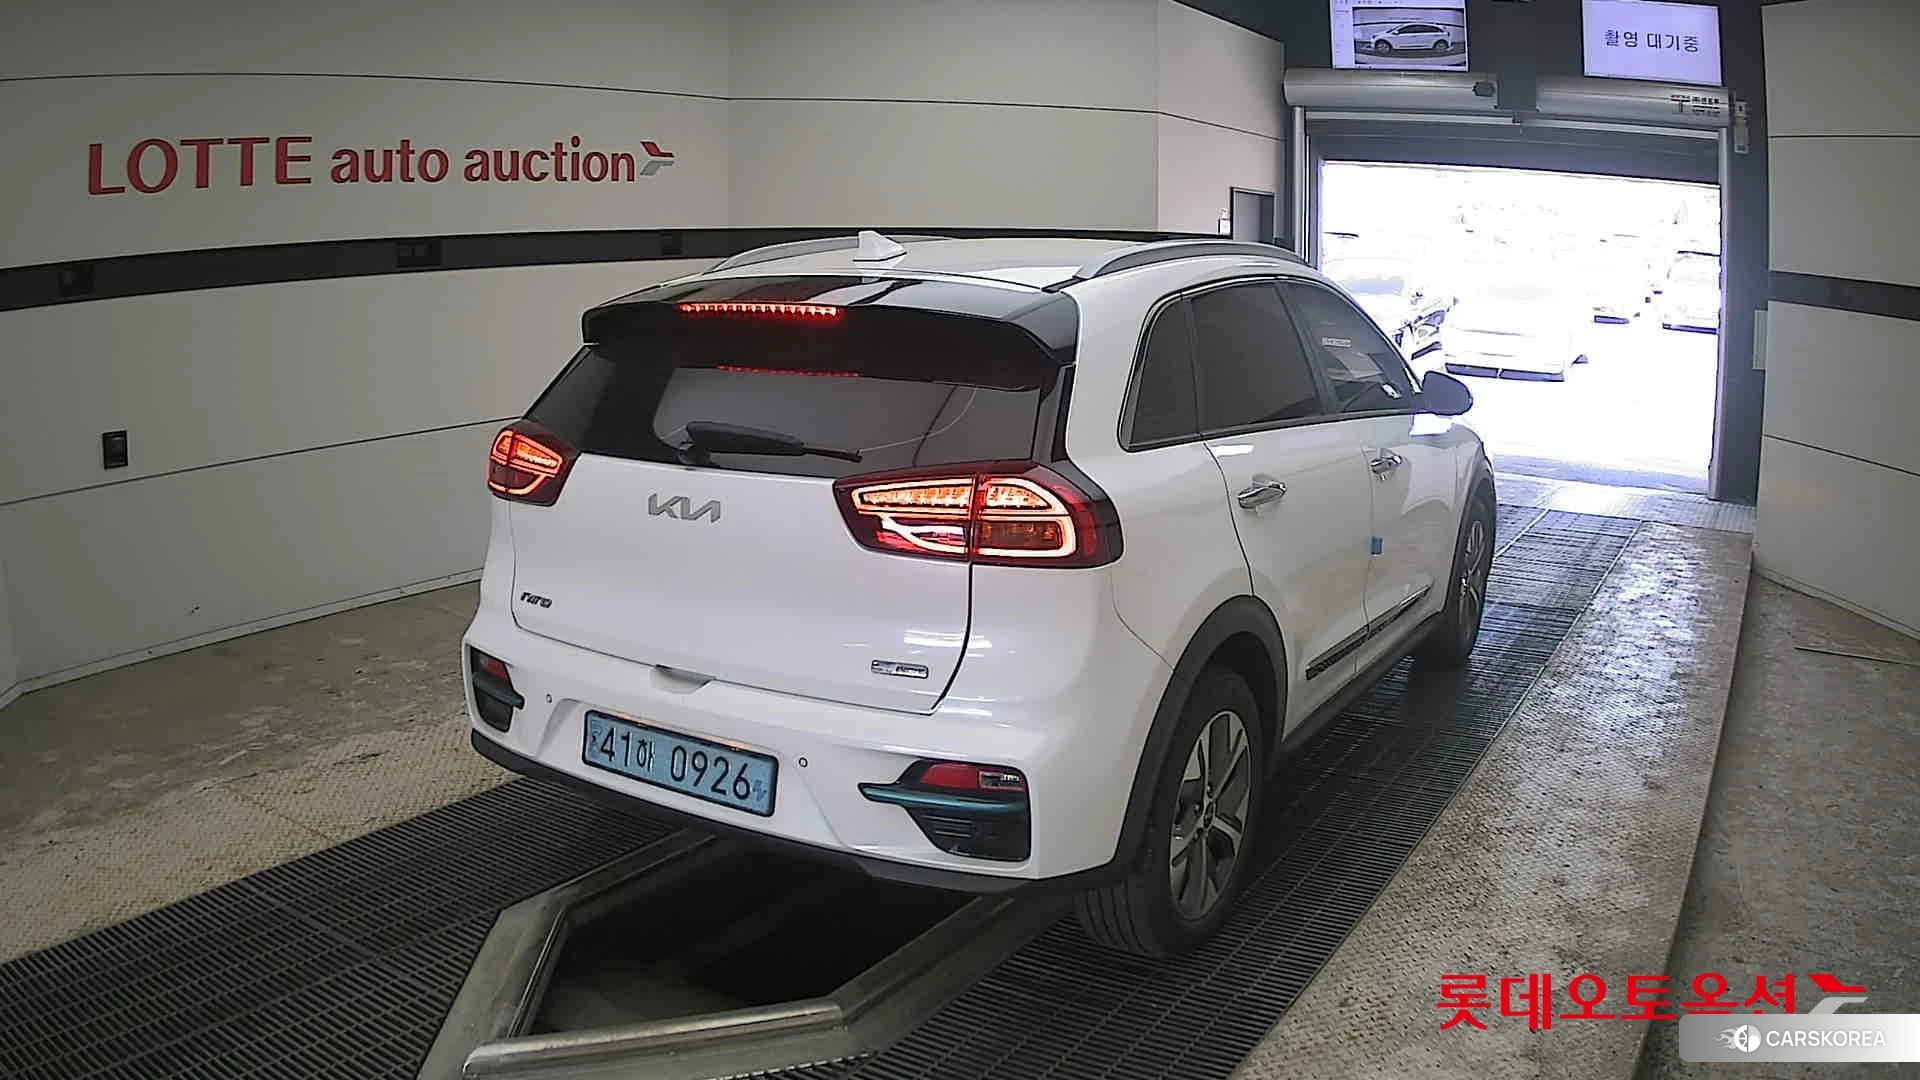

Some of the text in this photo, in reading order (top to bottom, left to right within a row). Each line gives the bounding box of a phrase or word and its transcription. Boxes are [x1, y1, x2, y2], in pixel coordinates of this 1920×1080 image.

[1646, 33, 1698, 53] 대기중
[88, 135, 636, 195] LOTTE auto auction
[670, 745, 751, 800] 0926
